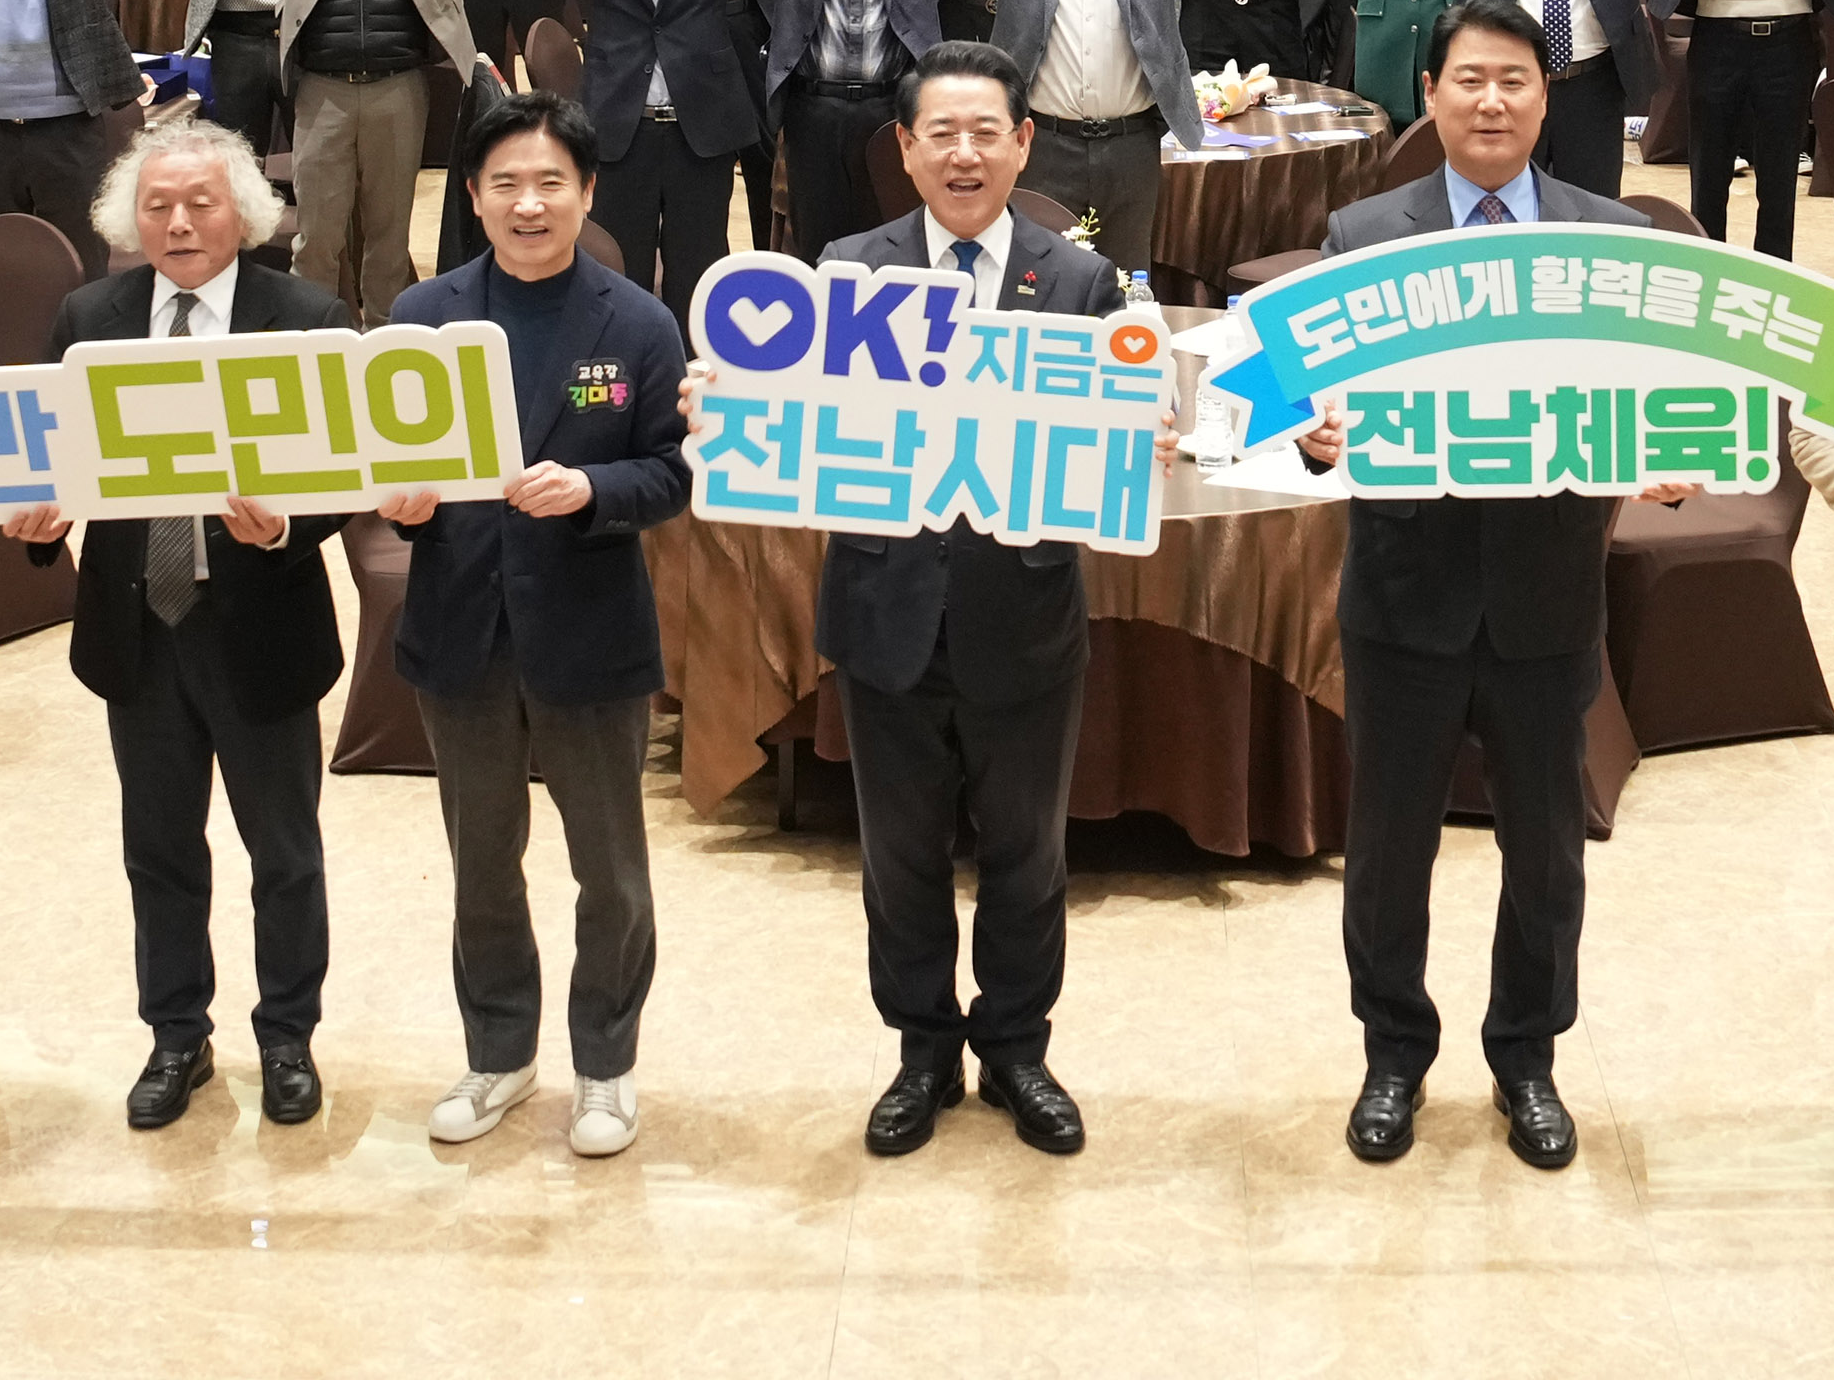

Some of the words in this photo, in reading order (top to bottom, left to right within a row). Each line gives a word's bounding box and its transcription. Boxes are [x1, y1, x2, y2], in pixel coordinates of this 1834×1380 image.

[704, 267, 960, 387] OK!
[969, 320, 1163, 398] 지금은
[1287, 259, 1517, 368] 도민에게
[1530, 254, 1704, 326] 활력을
[1710, 276, 1824, 363] 주는
[85, 341, 500, 502] 도민의
[701, 393, 1153, 542] 전남시대
[1345, 385, 1773, 487] 전남체육!
